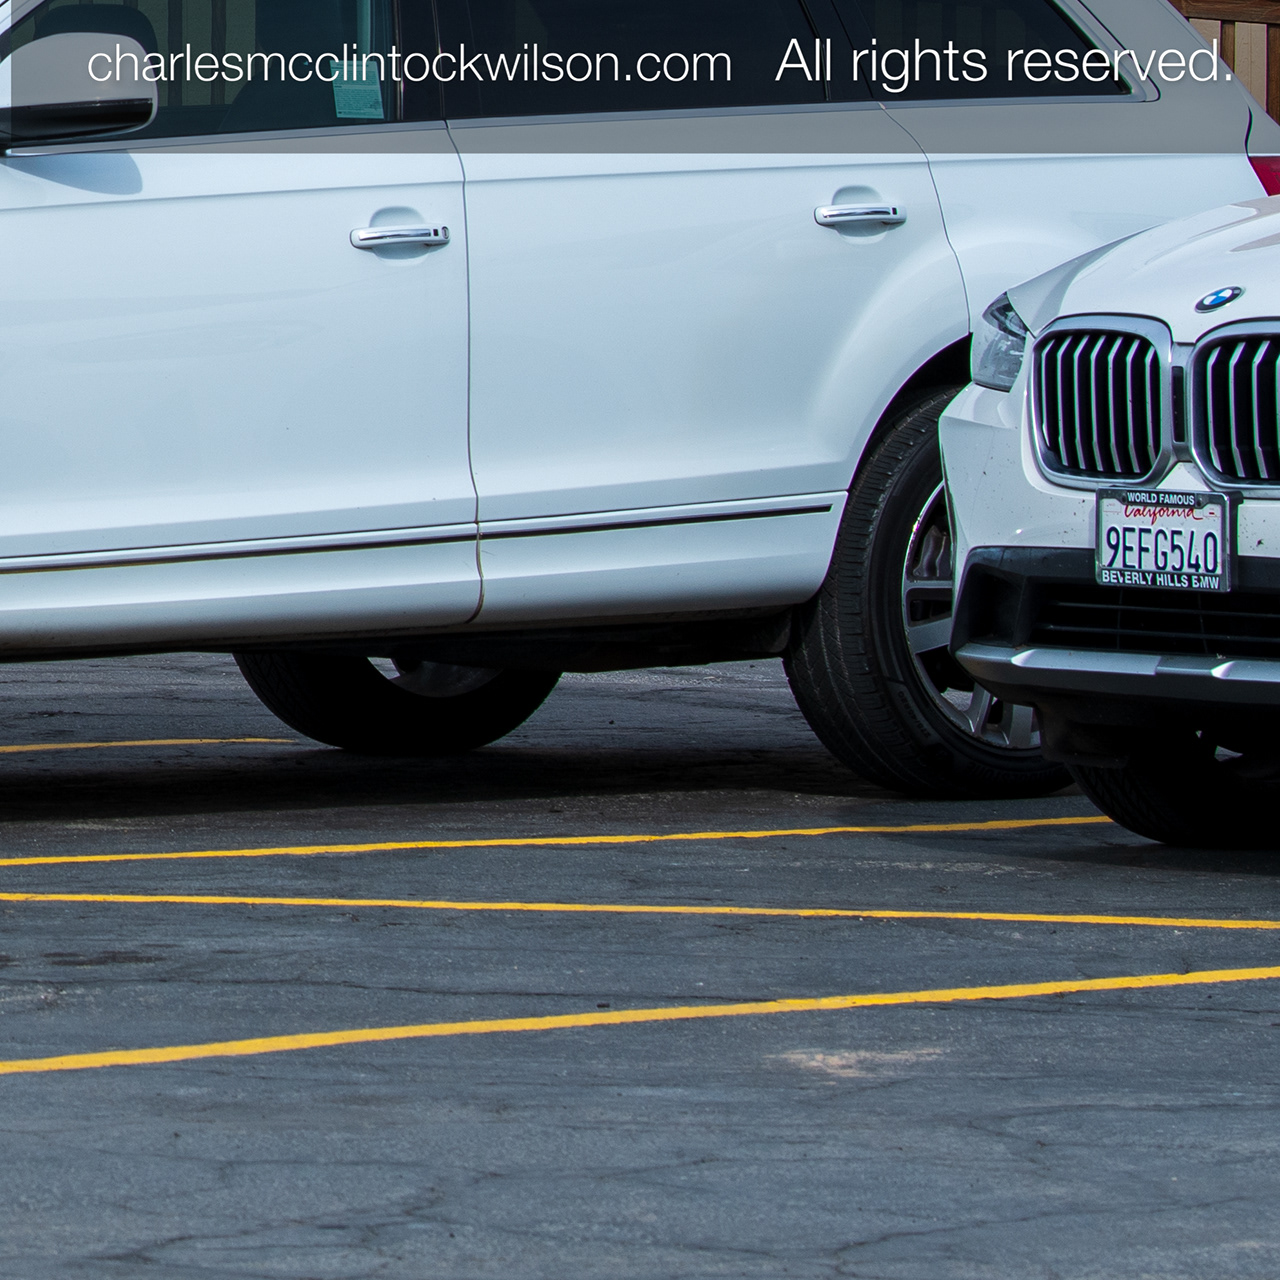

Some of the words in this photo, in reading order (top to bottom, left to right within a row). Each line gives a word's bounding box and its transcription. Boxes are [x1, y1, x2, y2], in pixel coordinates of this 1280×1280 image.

[1127, 492, 1157, 504] WORLD
[1159, 495, 1194, 505] FAMOUS
[1124, 506, 1203, 525] California
[1106, 526, 1218, 573] 9EFG540
[1102, 570, 1152, 585] BEVERLY
[1156, 573, 1188, 588] HILLS
[1191, 576, 1219, 589] BMW
